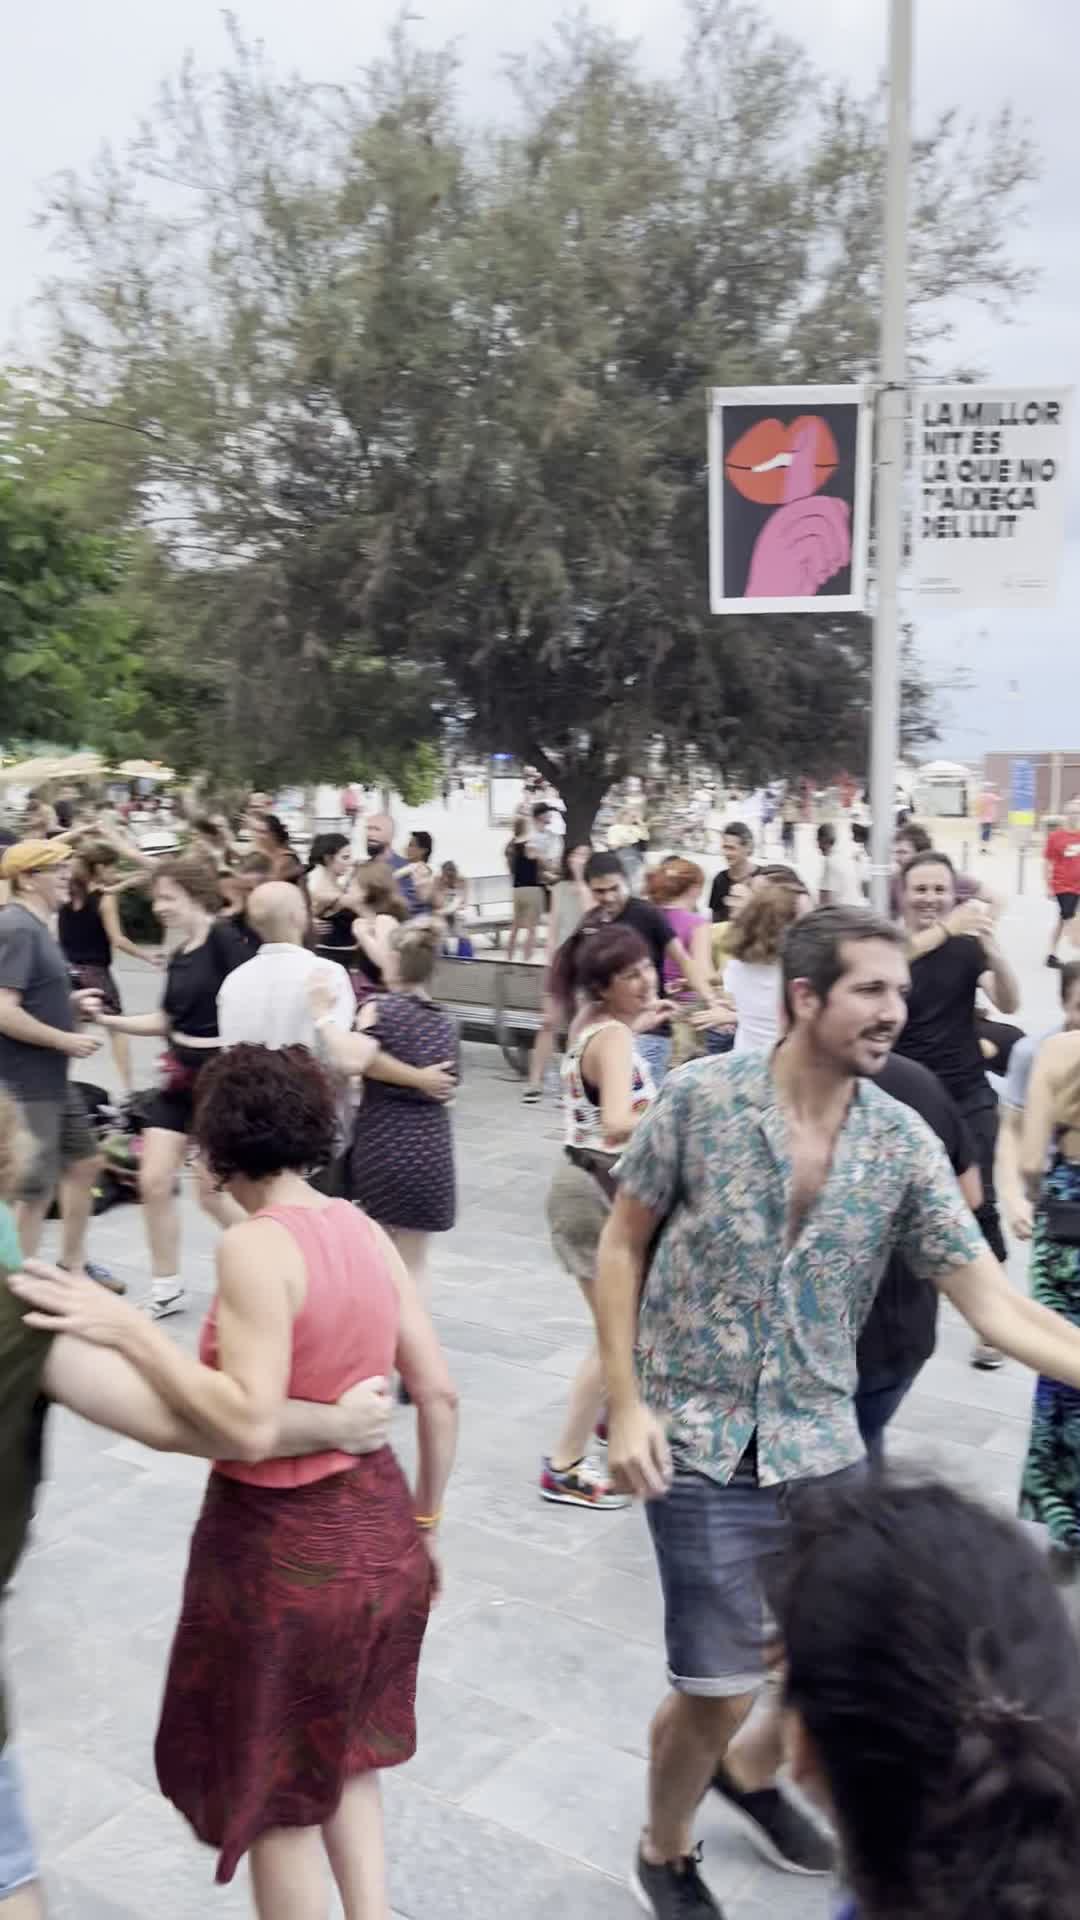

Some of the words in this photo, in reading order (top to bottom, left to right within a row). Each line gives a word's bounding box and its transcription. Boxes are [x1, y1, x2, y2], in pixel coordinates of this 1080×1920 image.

[923, 402, 951, 426] LA
[923, 460, 948, 483] LA
[958, 459, 1010, 482] QUE
